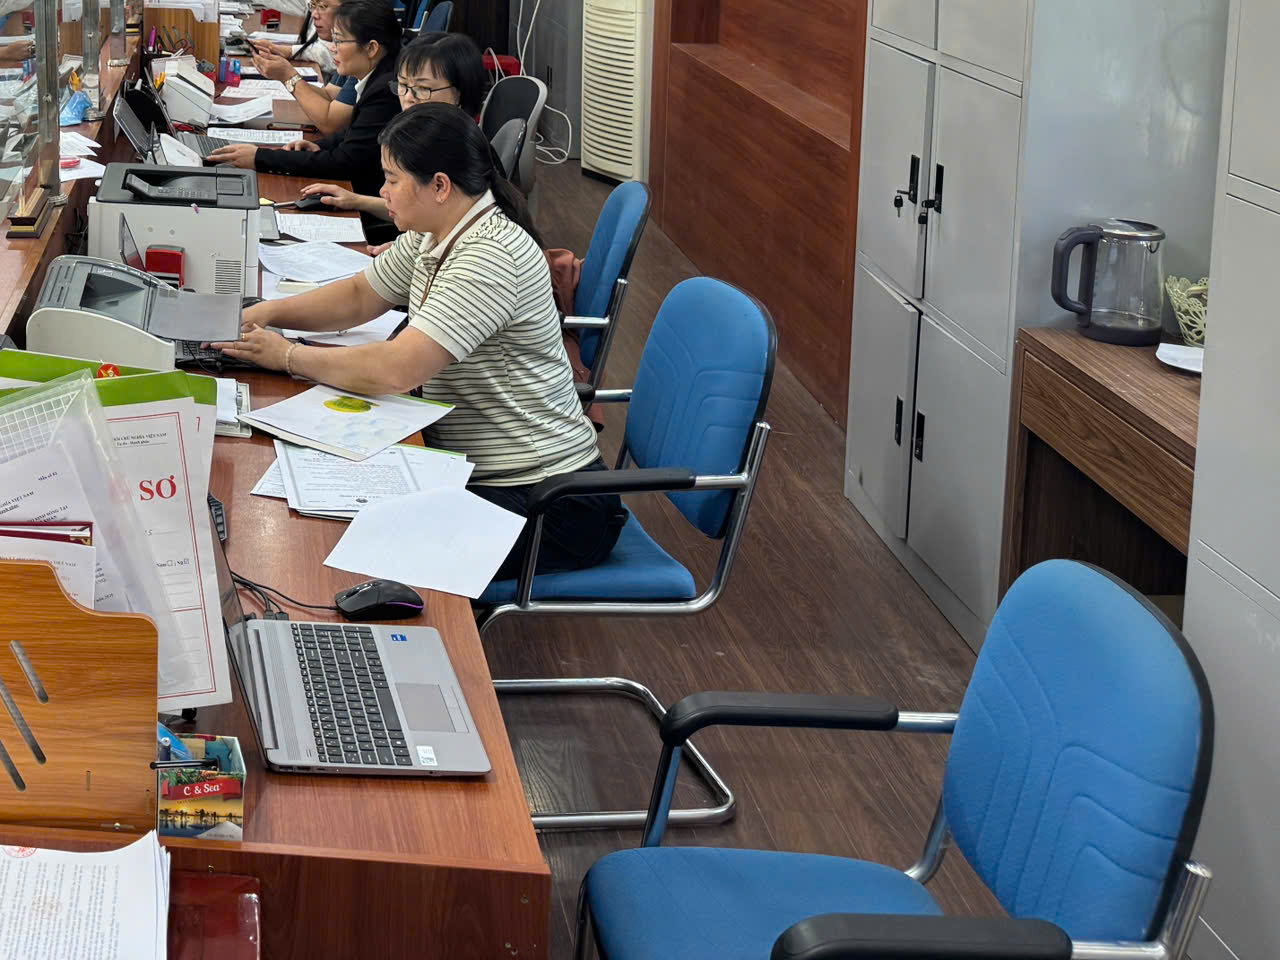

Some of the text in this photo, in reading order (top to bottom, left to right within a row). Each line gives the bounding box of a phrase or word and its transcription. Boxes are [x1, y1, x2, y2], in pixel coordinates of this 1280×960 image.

[139, 474, 177, 501] SƠ
[183, 783, 220, 796] C & Sea
